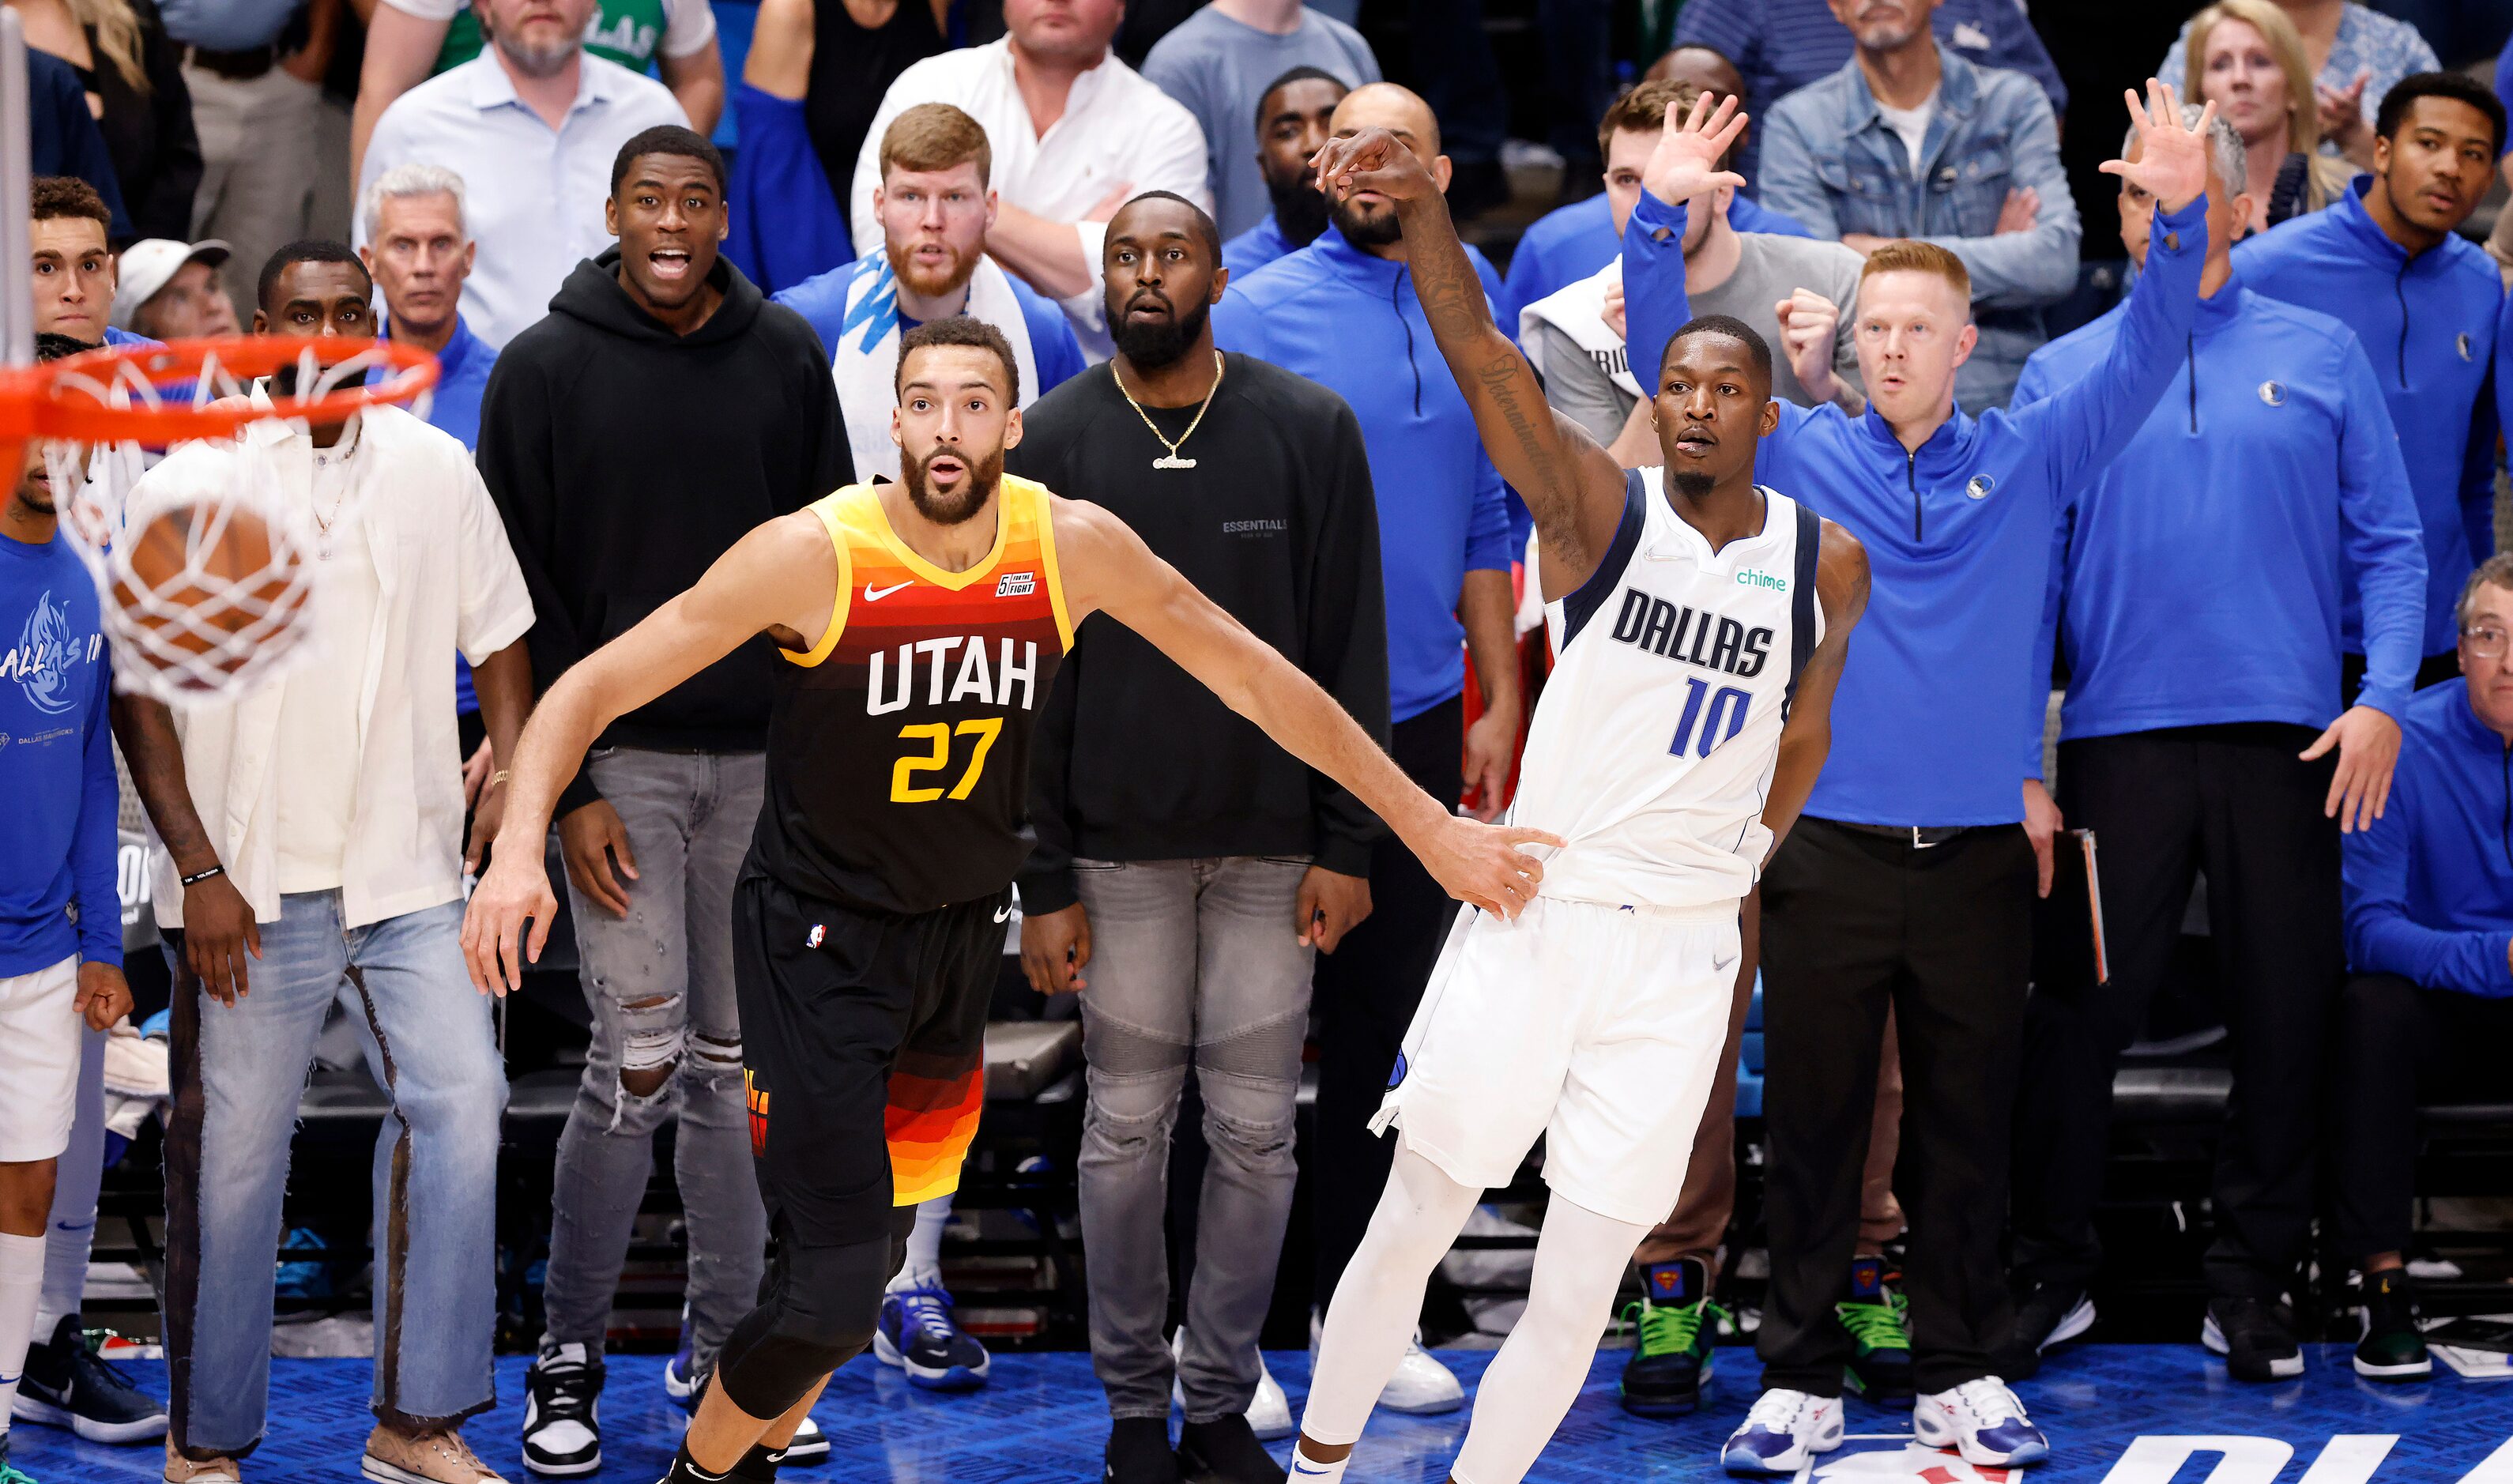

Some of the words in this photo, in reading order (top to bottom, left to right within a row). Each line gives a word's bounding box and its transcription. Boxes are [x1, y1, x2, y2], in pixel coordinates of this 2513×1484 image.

[998, 577, 1008, 594] 5
[1010, 584, 1033, 593] FIGHT
[1736, 569, 1786, 591] chime
[0, 637, 81, 684] ALLAS
[1610, 586, 1775, 679] DALLAS
[867, 635, 1037, 716] UTAH
[1667, 675, 1754, 760] 10
[891, 717, 1004, 803] 27
